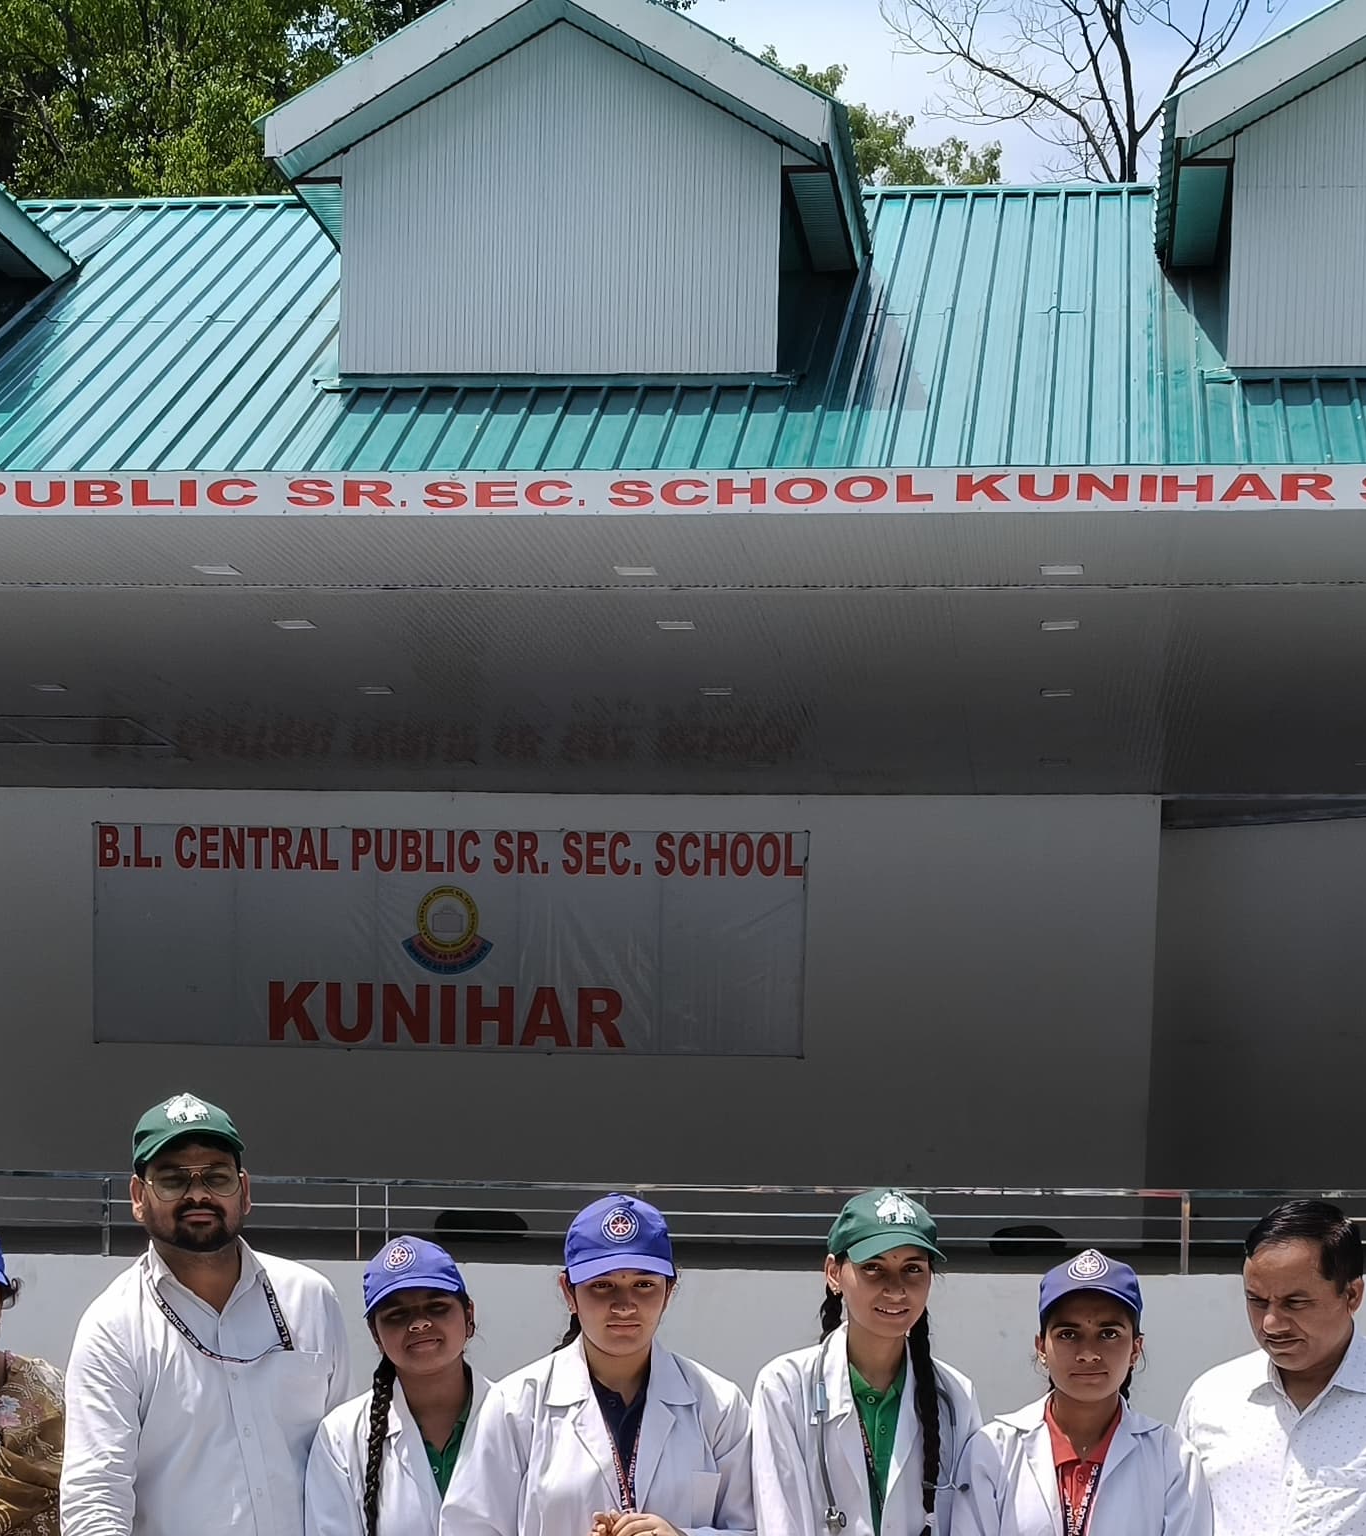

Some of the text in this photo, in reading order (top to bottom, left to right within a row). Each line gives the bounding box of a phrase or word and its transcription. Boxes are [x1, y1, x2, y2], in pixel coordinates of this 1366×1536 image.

[287, 478, 407, 509] SR.
[424, 479, 585, 511] SEC.
[609, 475, 934, 510] SCHOOL
[955, 472, 1335, 506] KUNIHAR
[98, 826, 804, 878] B.L. CENTRAL PUBLIC SR. SEC. SCHOOL
[268, 982, 626, 1048] KUNIHAR
